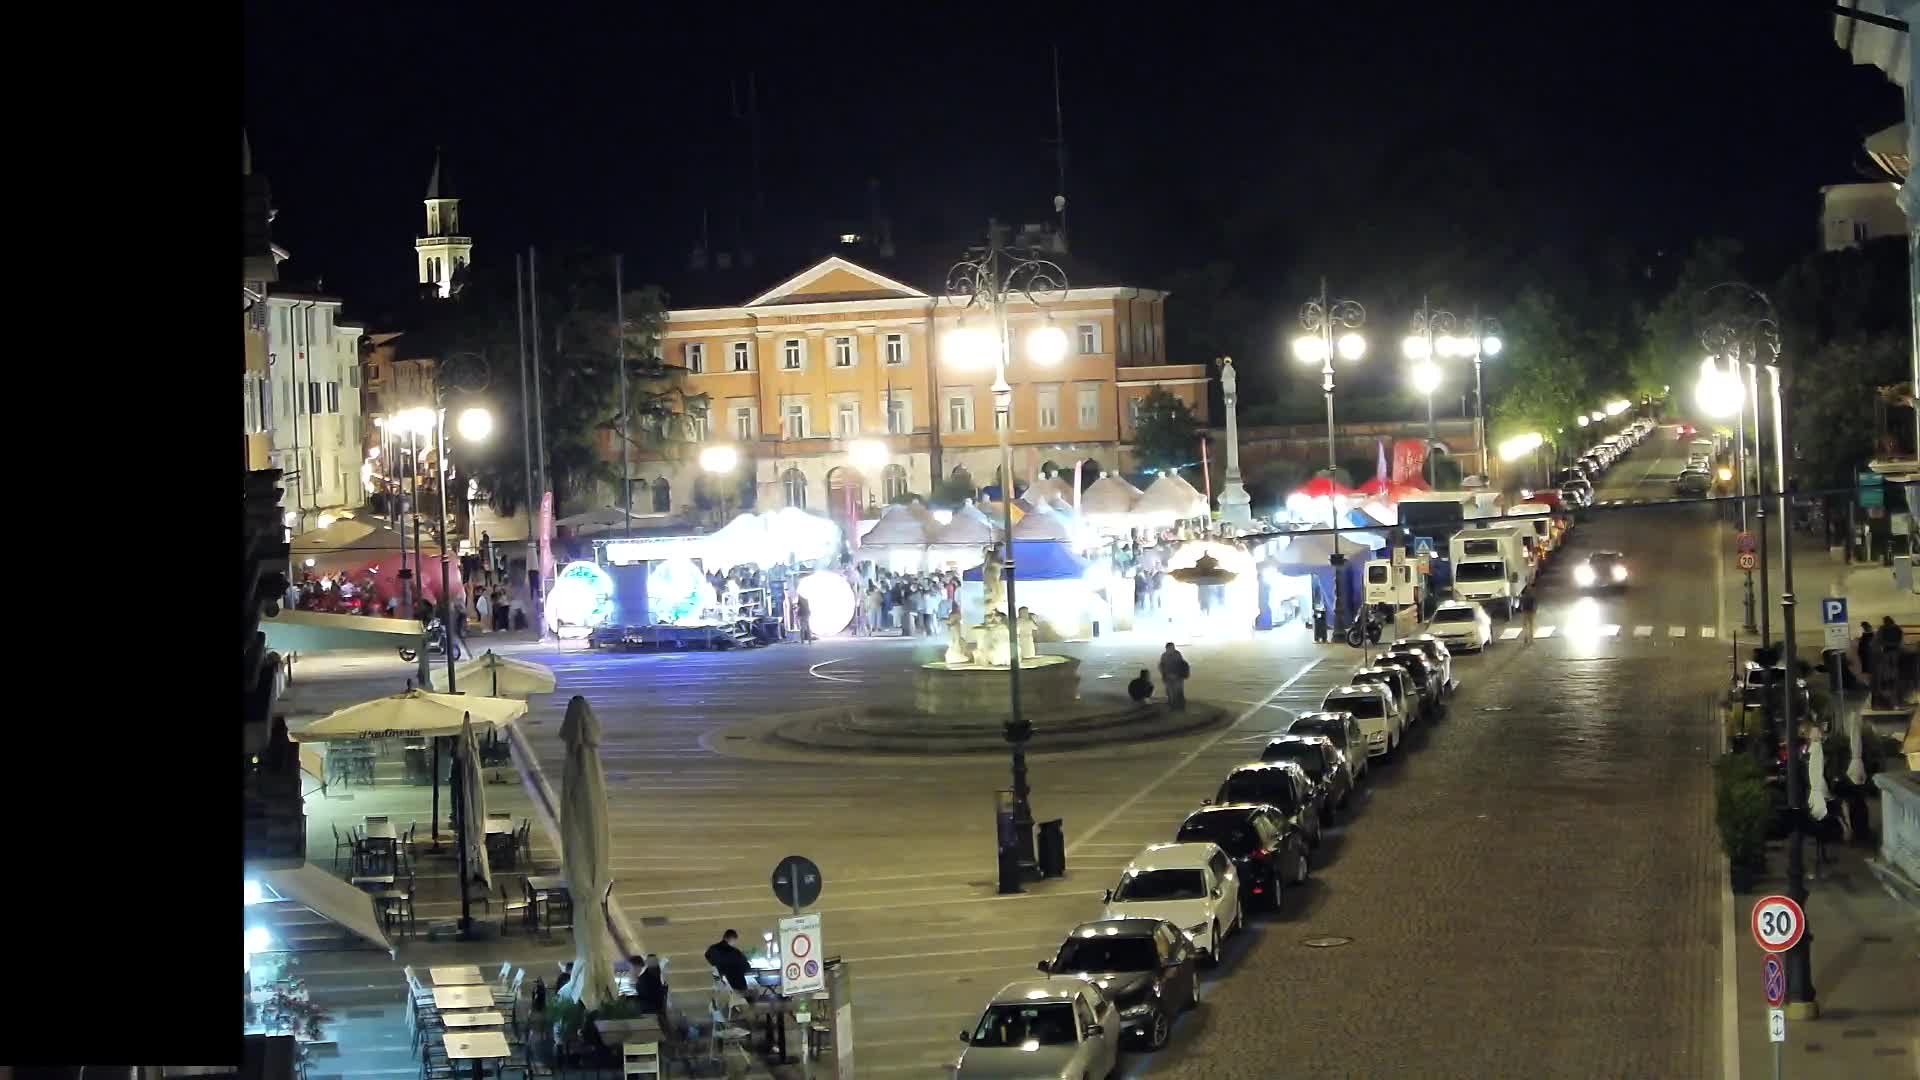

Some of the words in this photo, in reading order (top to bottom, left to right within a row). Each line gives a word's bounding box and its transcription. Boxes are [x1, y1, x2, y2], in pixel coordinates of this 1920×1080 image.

[1743, 557, 1752, 566] 20
[1827, 601, 1842, 620] P
[1762, 911, 1791, 937] 30
